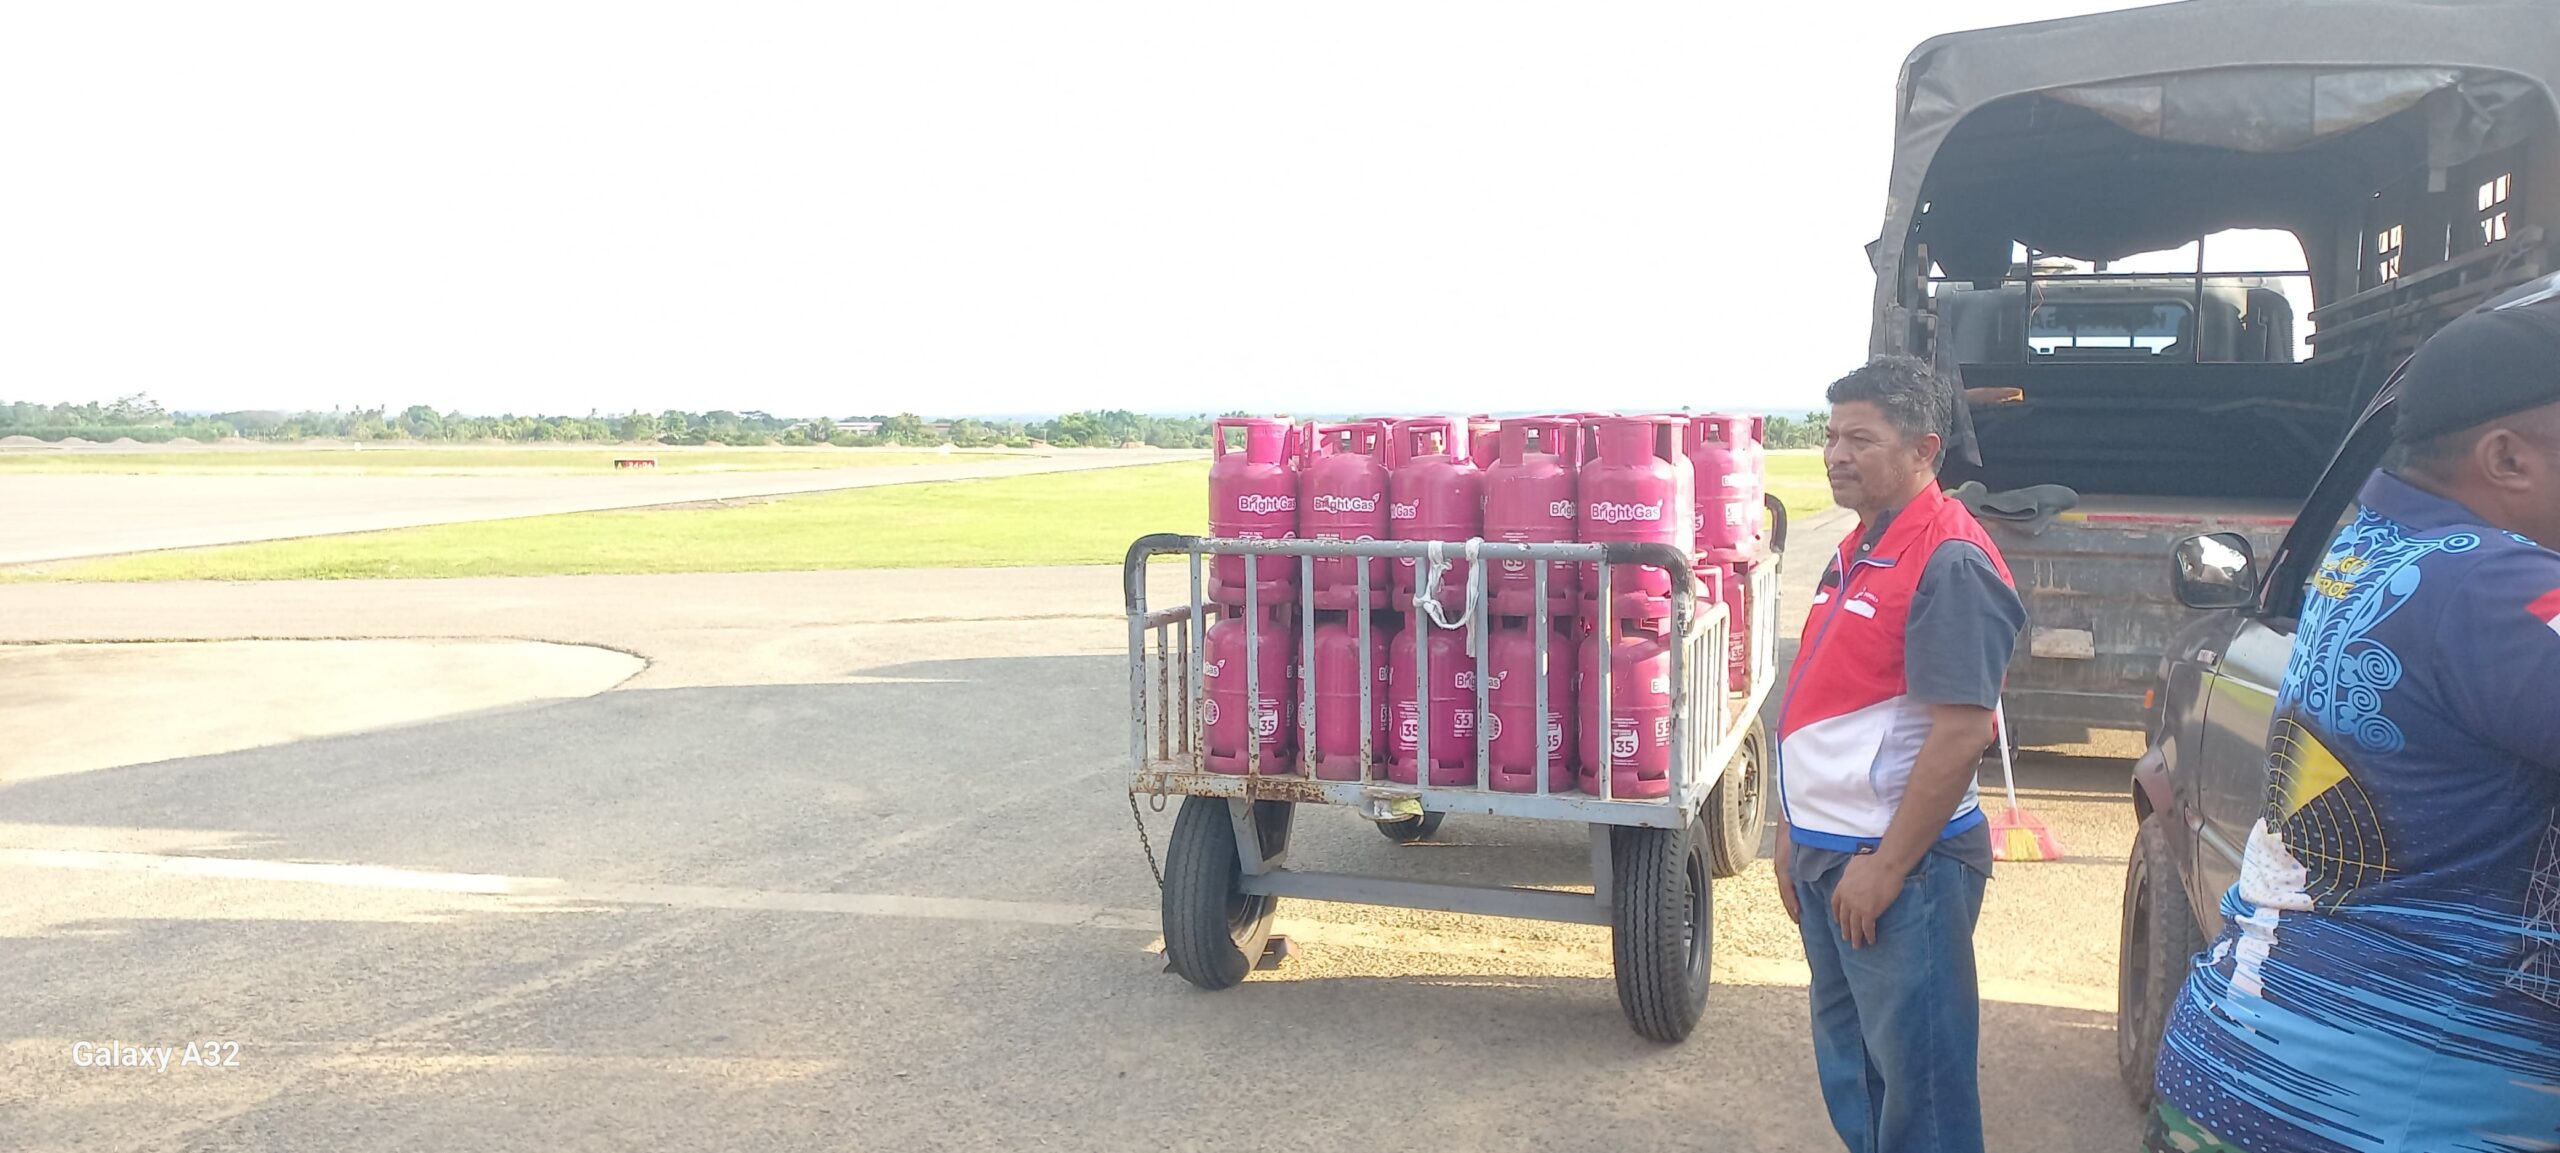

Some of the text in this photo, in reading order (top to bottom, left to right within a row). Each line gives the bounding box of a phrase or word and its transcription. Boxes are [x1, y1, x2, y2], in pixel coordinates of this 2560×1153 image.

[1240, 496, 1278, 514] Bright
[1314, 496, 1350, 513] Bright
[1351, 497, 1375, 511] Gas
[1396, 502, 1416, 518] Gas
[1591, 502, 1660, 522] Bright Gas
[1455, 671, 1476, 691] Brig
[1487, 677, 1500, 689] as
[1259, 720, 1276, 732] 35
